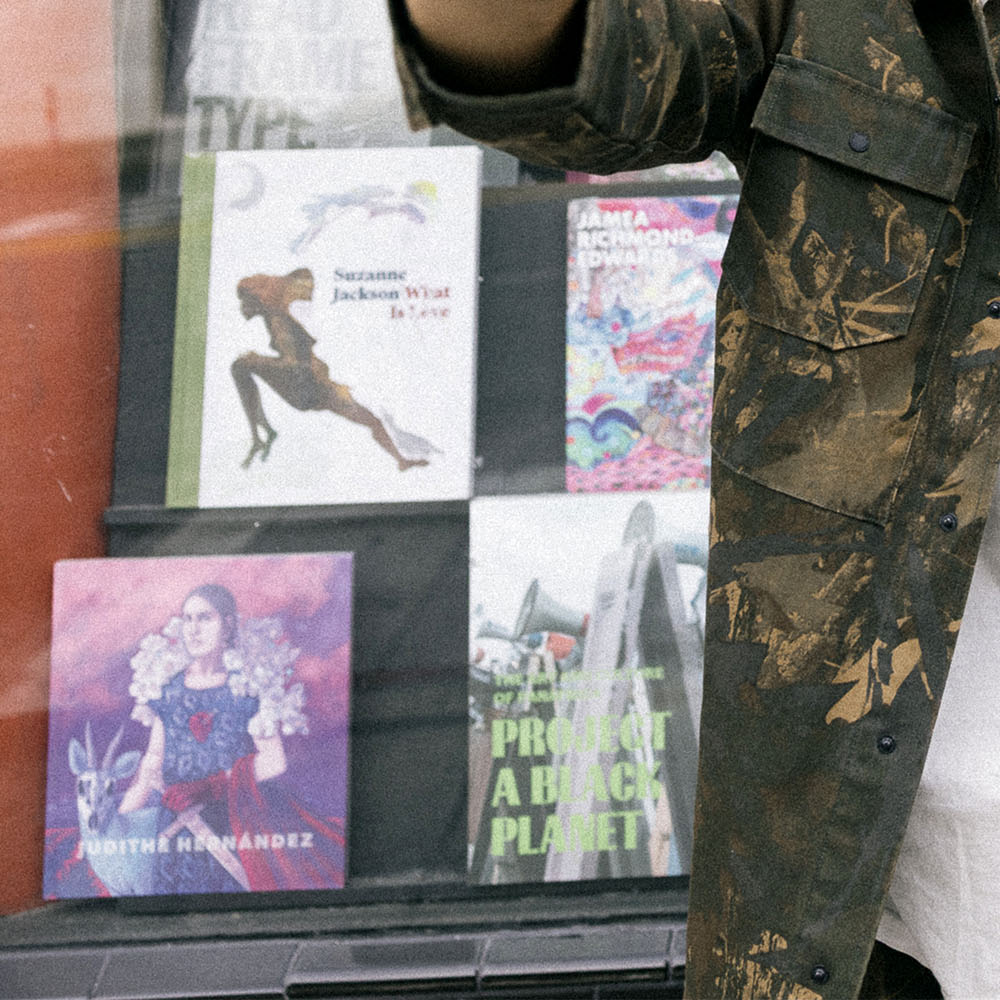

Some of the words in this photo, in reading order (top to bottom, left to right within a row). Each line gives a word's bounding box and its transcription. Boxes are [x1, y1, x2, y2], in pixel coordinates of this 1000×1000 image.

[193, 96, 318, 150] TYPE
[330, 286, 399, 304] Jackson
[333, 266, 407, 281] Suzanne
[491, 712, 673, 758] PROJECT
[491, 767, 521, 807] A
[530, 761, 662, 805] BLACK
[491, 810, 644, 856] PLANET
